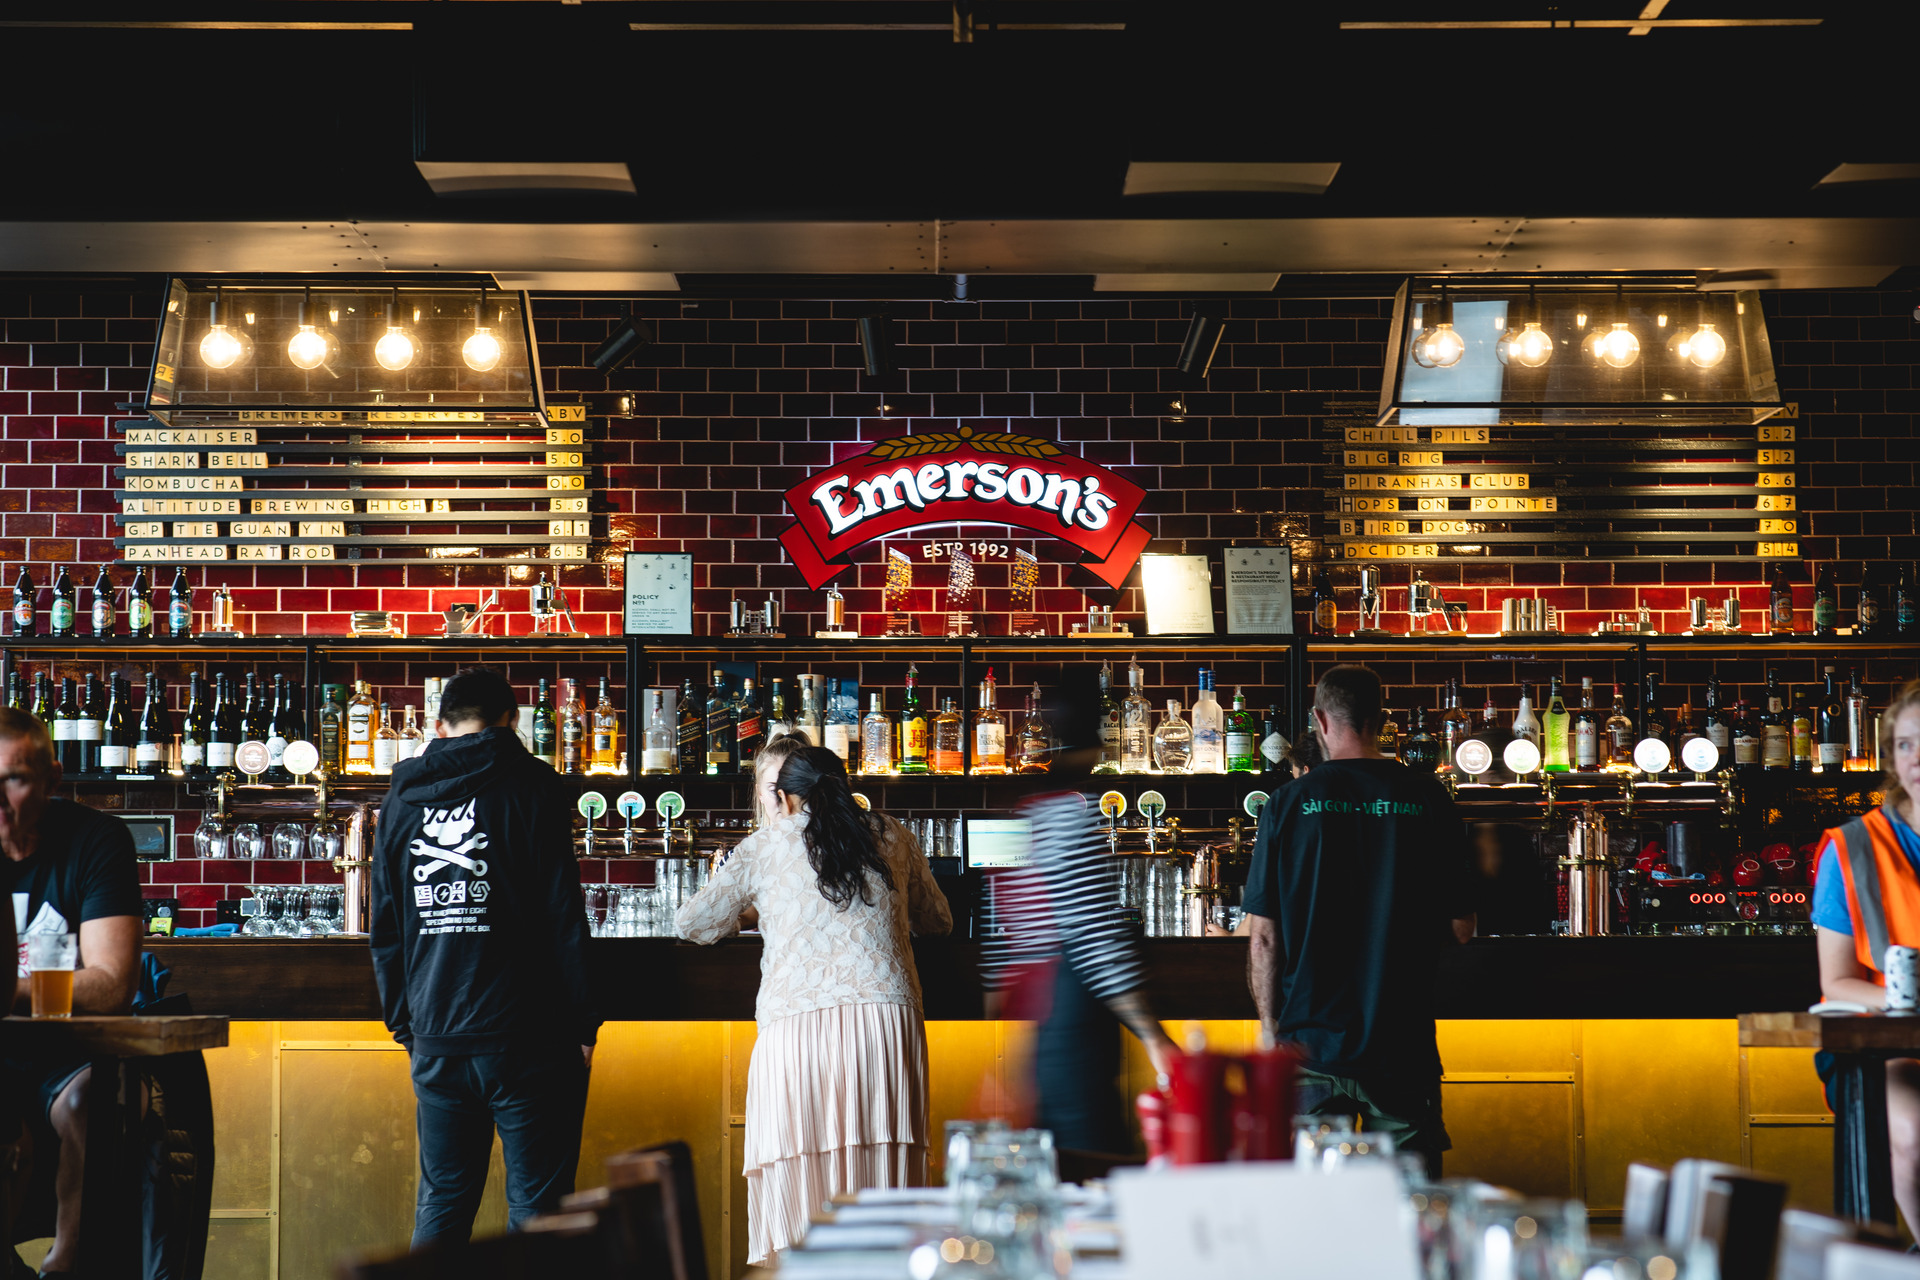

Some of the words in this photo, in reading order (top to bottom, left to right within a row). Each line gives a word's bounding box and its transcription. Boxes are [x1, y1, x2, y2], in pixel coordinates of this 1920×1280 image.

[546, 408, 583, 419] ABV
[128, 432, 253, 443] MACKAISER
[551, 432, 581, 443] 5.0
[1348, 430, 1415, 441] CHILL
[1434, 430, 1486, 441] PILS
[1763, 429, 1792, 440] 5.2
[129, 456, 200, 467] SHARK
[212, 456, 263, 466] BELL
[551, 454, 581, 464] 5.0
[1349, 454, 1388, 464] BIG
[1402, 453, 1441, 464] RIG
[1763, 452, 1791, 462] 5.2
[127, 479, 240, 490] KOMBUCHA
[1349, 477, 1458, 488] PIRANHAS
[1474, 476, 1526, 487] CLUB
[1763, 475, 1792, 486] 6.6
[811, 460, 1117, 536] Emerson's
[1343, 499, 1395, 510] HOPS
[1421, 499, 1446, 510] ON
[1475, 498, 1554, 509] POINTE
[1763, 498, 1792, 508] 6.7
[126, 501, 236, 512] ALTITUDE
[254, 500, 351, 511] BREWING
[370, 501, 422, 511] HIGH
[437, 501, 444, 511] 5
[555, 500, 584, 510] 5.9
[128, 525, 159, 536] G.P
[177, 524, 213, 535] TIE
[233, 524, 288, 536] GUAN
[303, 524, 341, 535] YIN
[554, 523, 585, 534] 6.1
[1425, 522, 1465, 532] DOG
[1765, 520, 1795, 531] 7.0
[128, 547, 224, 558] PANHEAD
[240, 546, 279, 557] RAT
[292, 546, 331, 558] ROD
[554, 547, 584, 557] 6.5
[969, 542, 1009, 559] 1992
[1347, 545, 1435, 558] D'CIDER
[1763, 543, 1795, 554] 5.4
